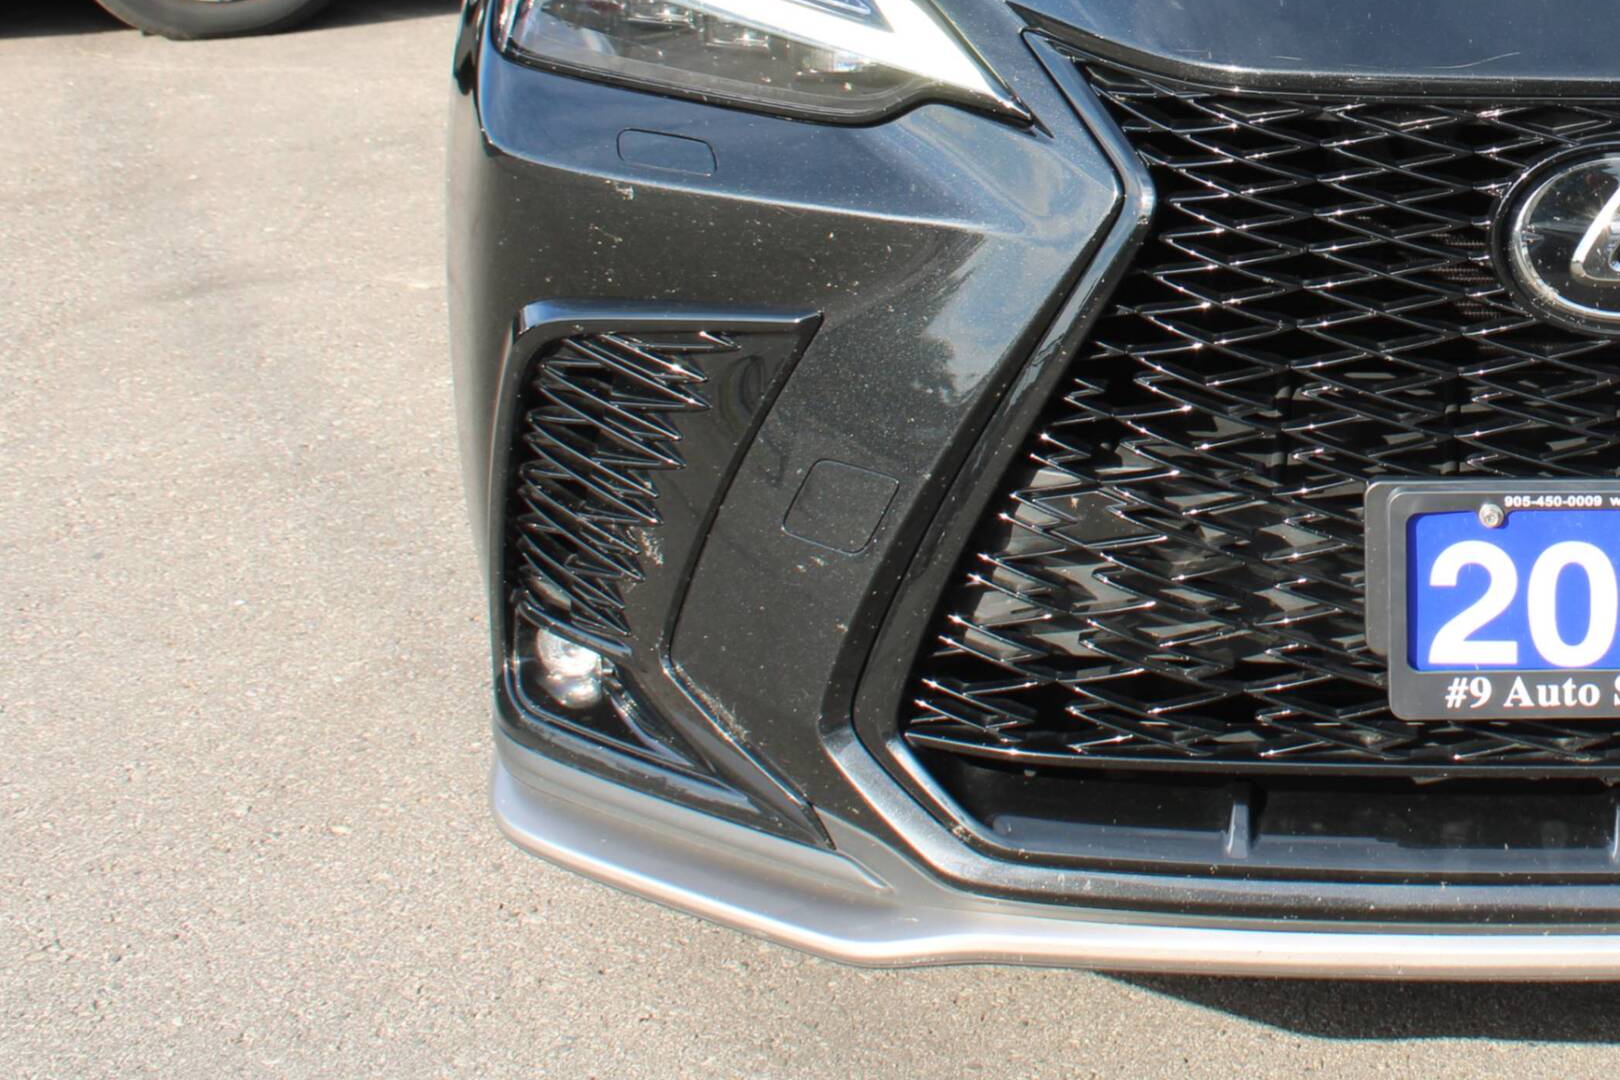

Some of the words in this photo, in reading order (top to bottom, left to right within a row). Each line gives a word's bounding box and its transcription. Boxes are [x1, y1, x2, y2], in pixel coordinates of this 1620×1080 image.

[1504, 495, 1603, 508] 905-450-0009
[1445, 676, 1492, 709] #9
[1503, 676, 1601, 708] Auto
